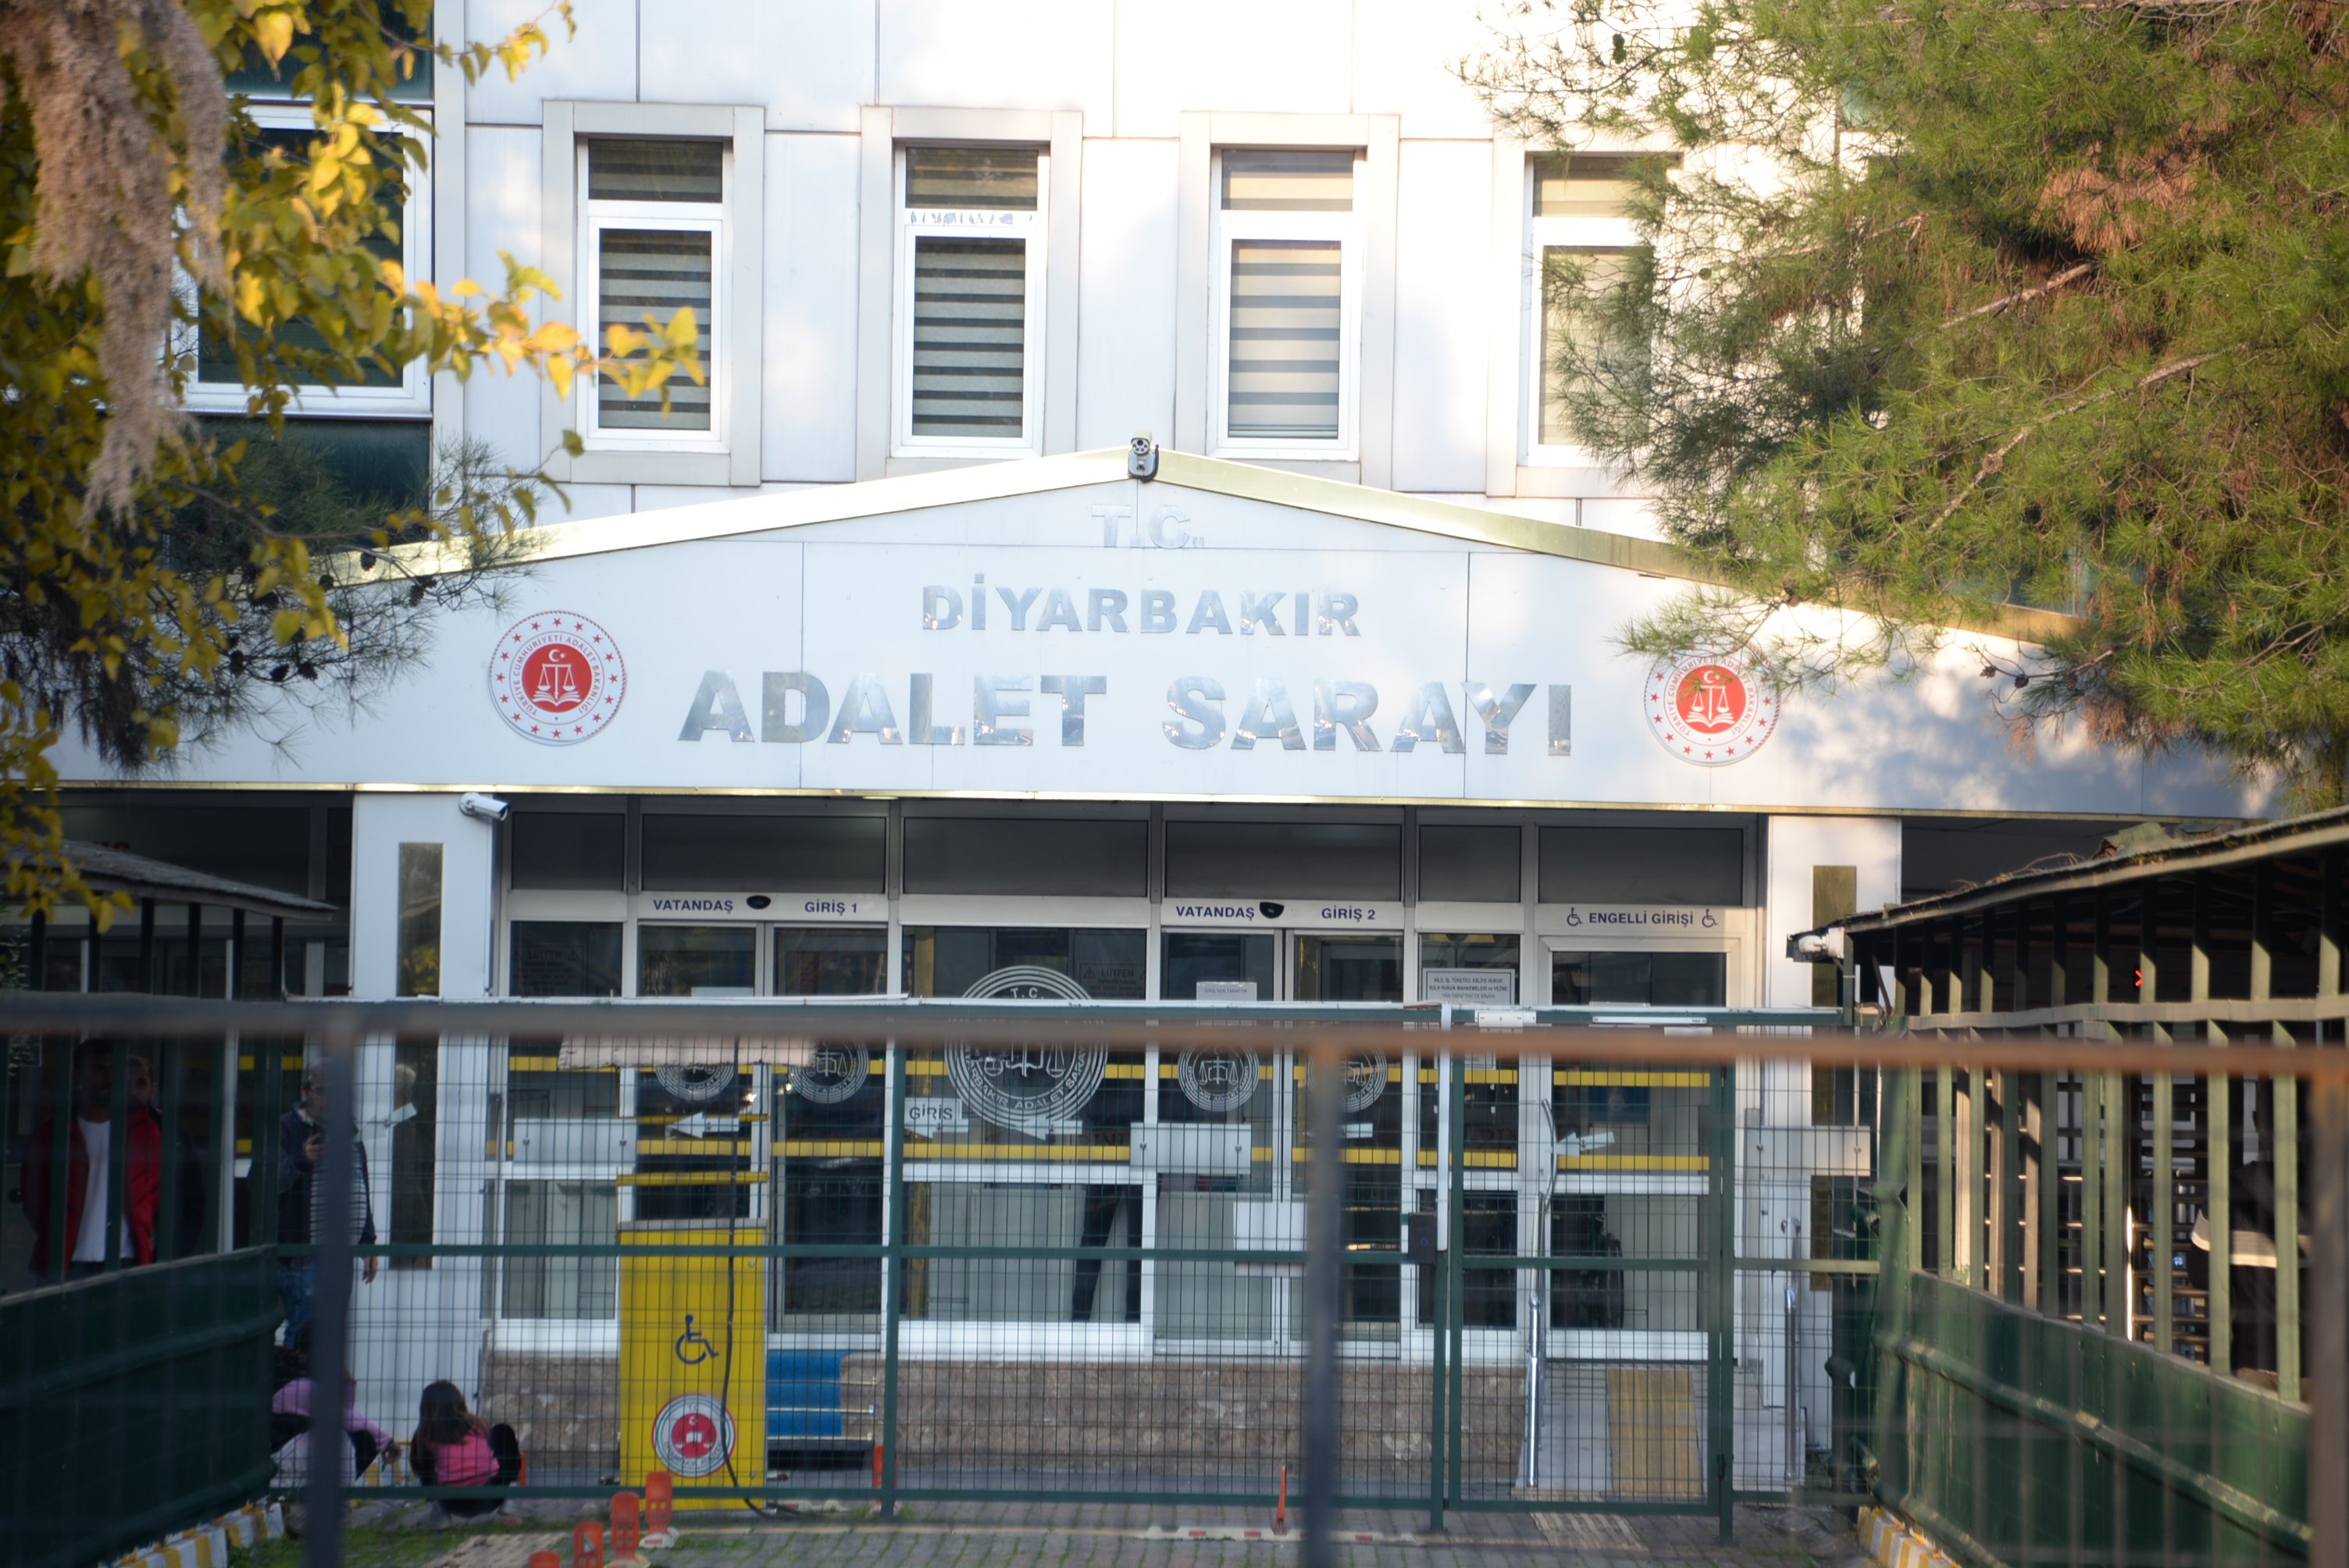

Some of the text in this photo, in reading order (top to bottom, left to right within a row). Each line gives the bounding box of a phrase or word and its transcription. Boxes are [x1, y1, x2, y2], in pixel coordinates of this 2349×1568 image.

[1091, 504, 1205, 549] T.C.
[922, 572, 1361, 636] DİYARBAKIR
[512, 634, 601, 715] TÜRKİYE CUMHURİYETİ ADALET BAKANLIĞI
[1721, 658, 1751, 682] ADAET
[677, 670, 1571, 756] ADALET SARAYI
[1667, 700, 1691, 736] TÜRKİYE
[1731, 687, 1755, 736] BAKANLIĞI
[654, 899, 857, 916] VATANDAŞ GİRİŞ 1
[1176, 905, 1375, 921] VATANDAŞ GİRİŞ 2
[1588, 910, 1693, 927] ENGELLİ GİRİŞİ
[1014, 1089, 1064, 1110] ADALET
